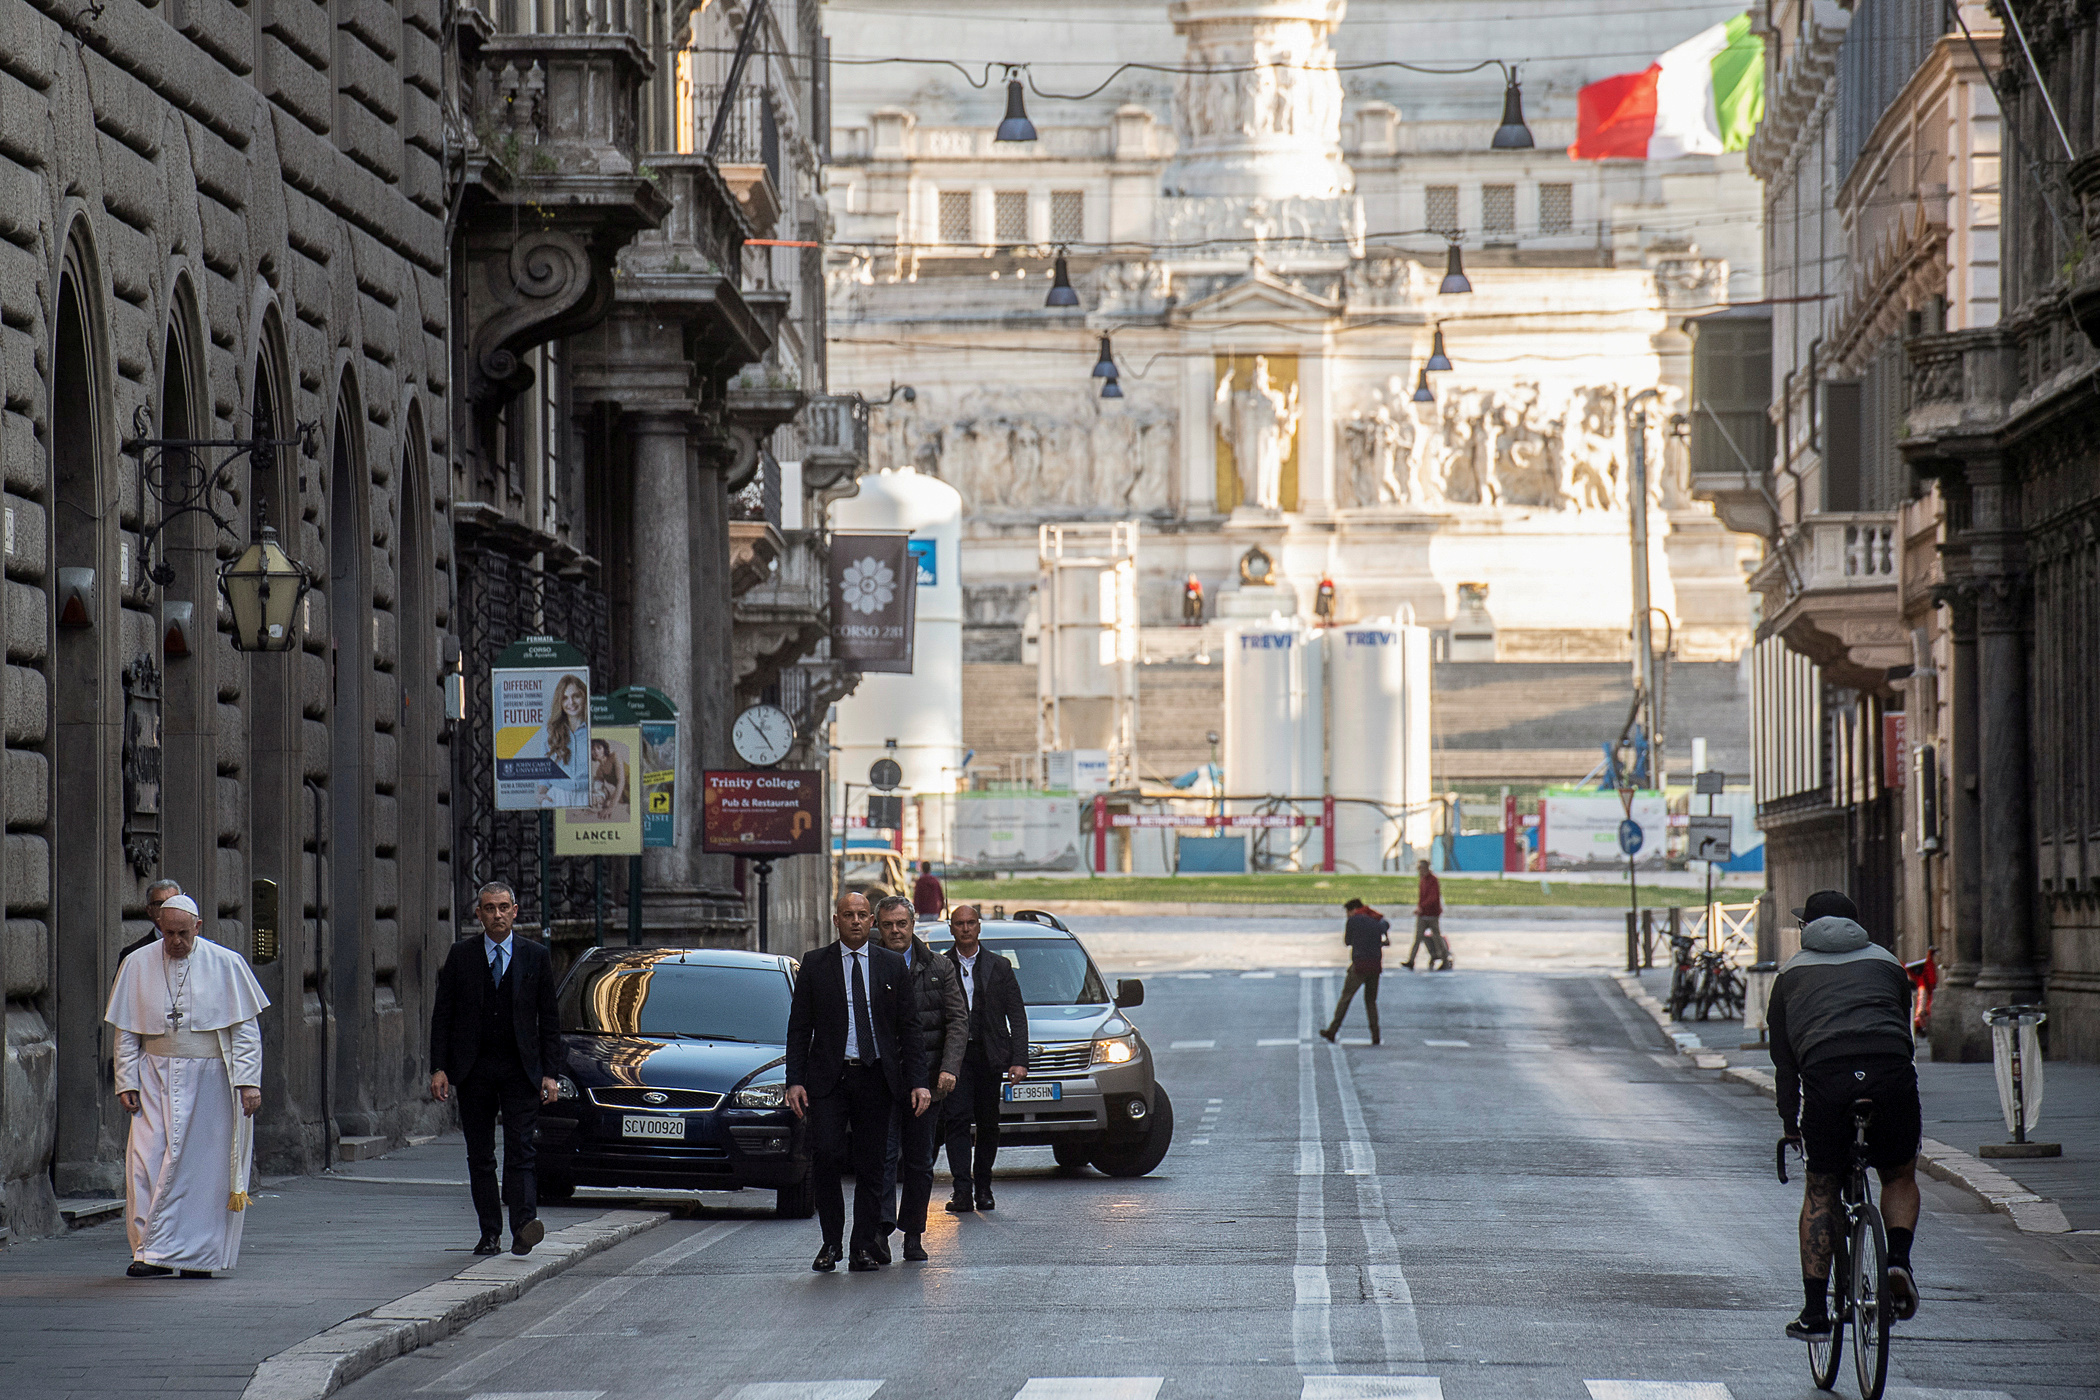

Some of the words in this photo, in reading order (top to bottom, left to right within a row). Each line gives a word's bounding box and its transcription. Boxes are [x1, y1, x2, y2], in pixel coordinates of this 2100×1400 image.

[831, 624, 881, 639] CORSO
[526, 635, 554, 643] FERMATA
[1240, 634, 1292, 649] TREVI
[528, 646, 552, 654] CORSO
[503, 680, 543, 692] DIFFERENT
[503, 709, 544, 724] FUTURE
[757, 707, 769, 718] 12
[735, 731, 743, 739] 9
[760, 752, 767, 762] 6
[710, 777, 753, 790] Trinity
[756, 777, 801, 790] College
[721, 798, 740, 807] Pub
[741, 798, 750, 807] &
[752, 798, 800, 808] Restaurant
[575, 830, 621, 840] LANCEL
